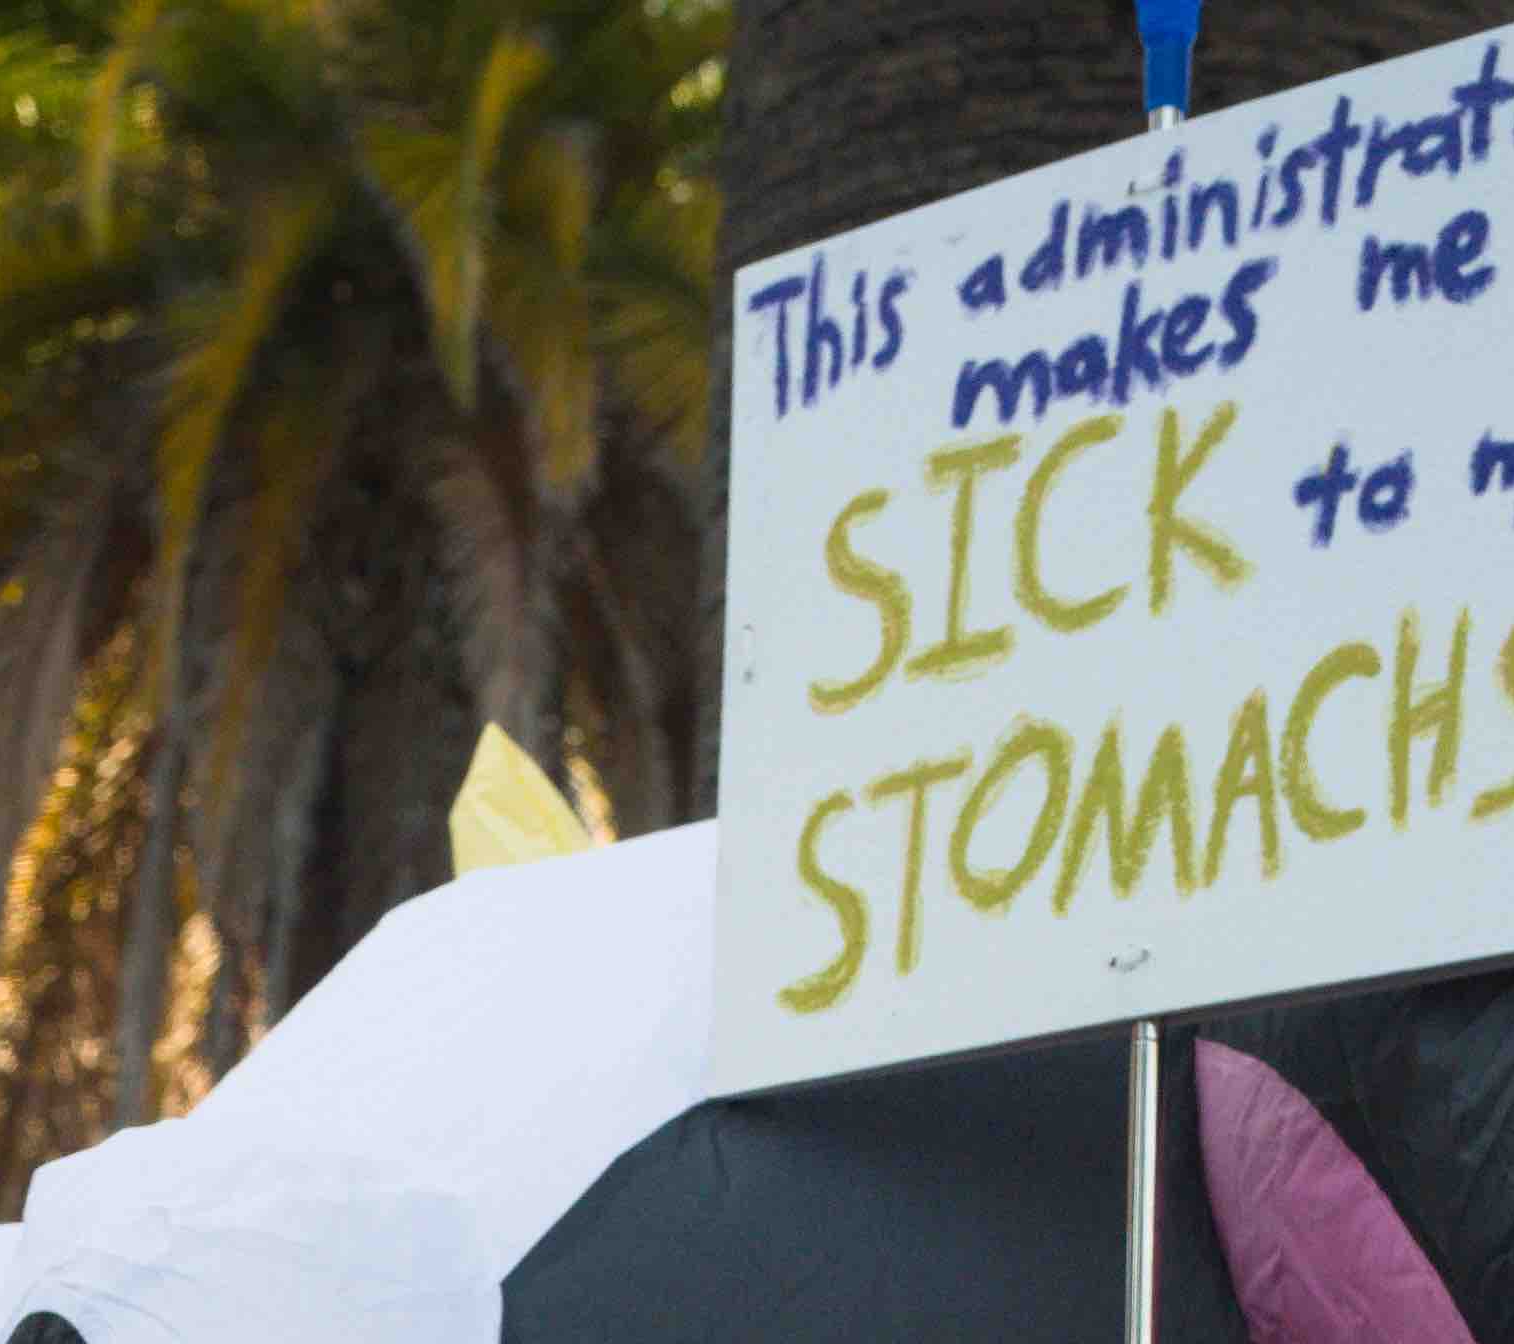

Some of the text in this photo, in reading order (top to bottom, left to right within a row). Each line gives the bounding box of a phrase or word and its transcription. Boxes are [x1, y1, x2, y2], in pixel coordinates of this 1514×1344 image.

[745, 256, 912, 418] This
[952, 208, 1498, 431] makes me
[808, 400, 1255, 717] SICK
[1293, 442, 1416, 548] to
